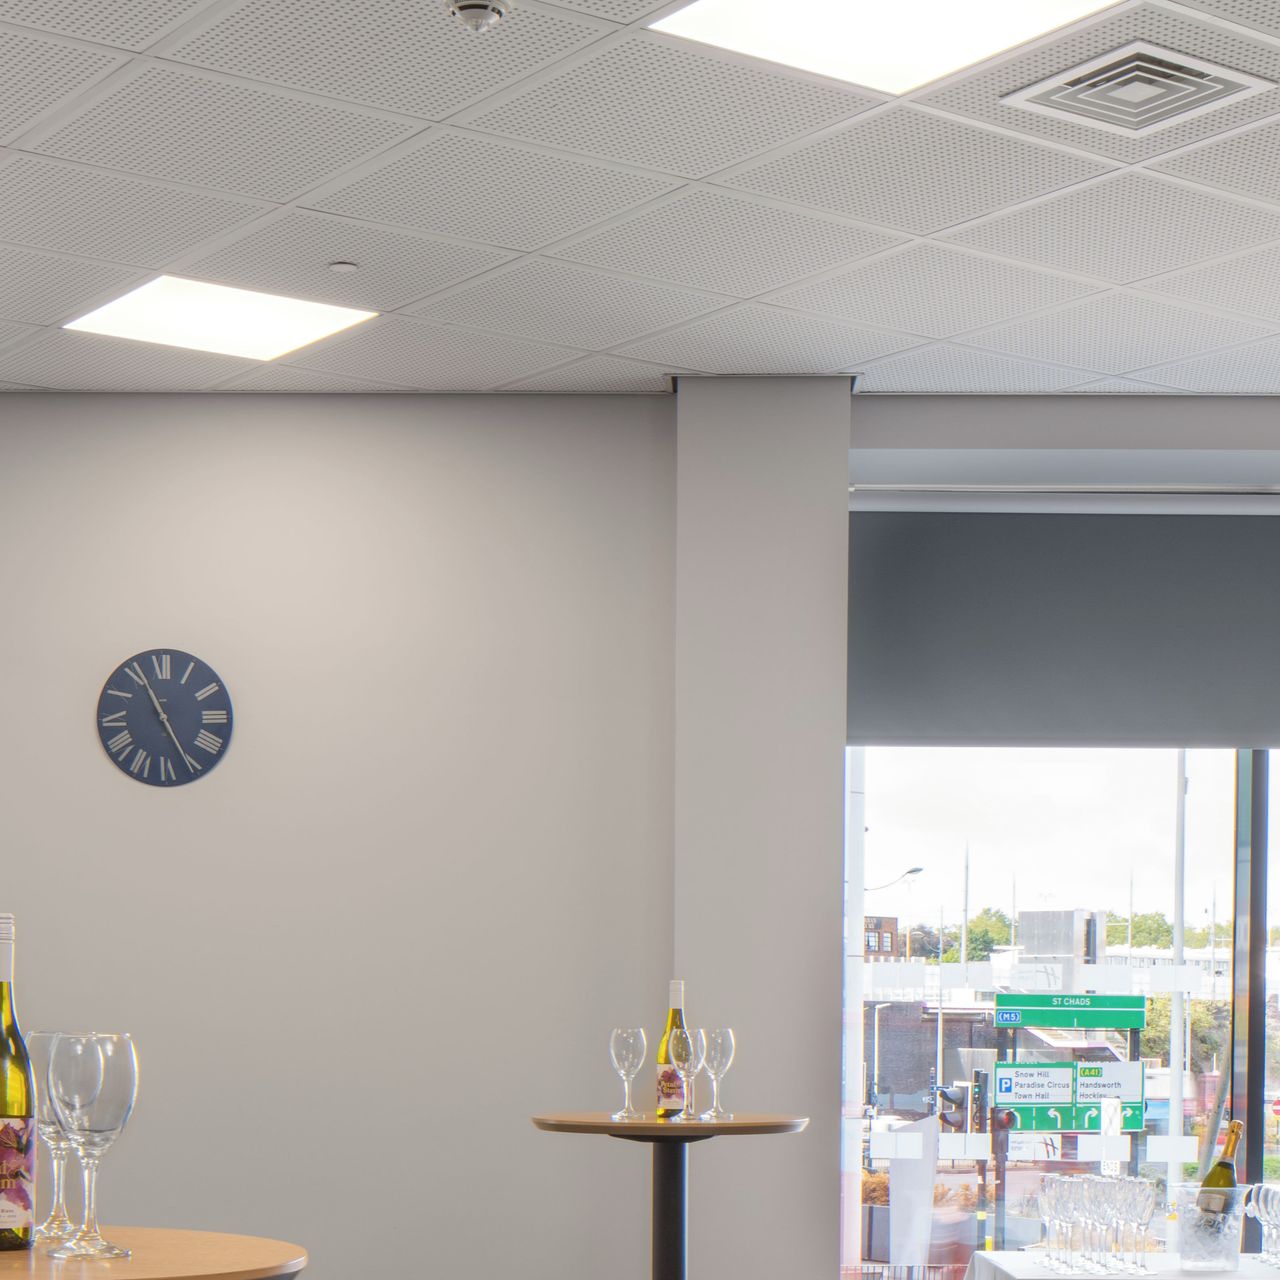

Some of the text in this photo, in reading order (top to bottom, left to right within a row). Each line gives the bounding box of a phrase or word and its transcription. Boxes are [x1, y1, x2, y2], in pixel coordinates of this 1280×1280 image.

[1052, 998, 1091, 1006] ST CHADS
[998, 1012, 1021, 1023] (M5)
[1080, 1068, 1102, 1077] (A41)
[1015, 1081, 1070, 1089] Paradise Circus
[1079, 1081, 1122, 1089] Handsworth
